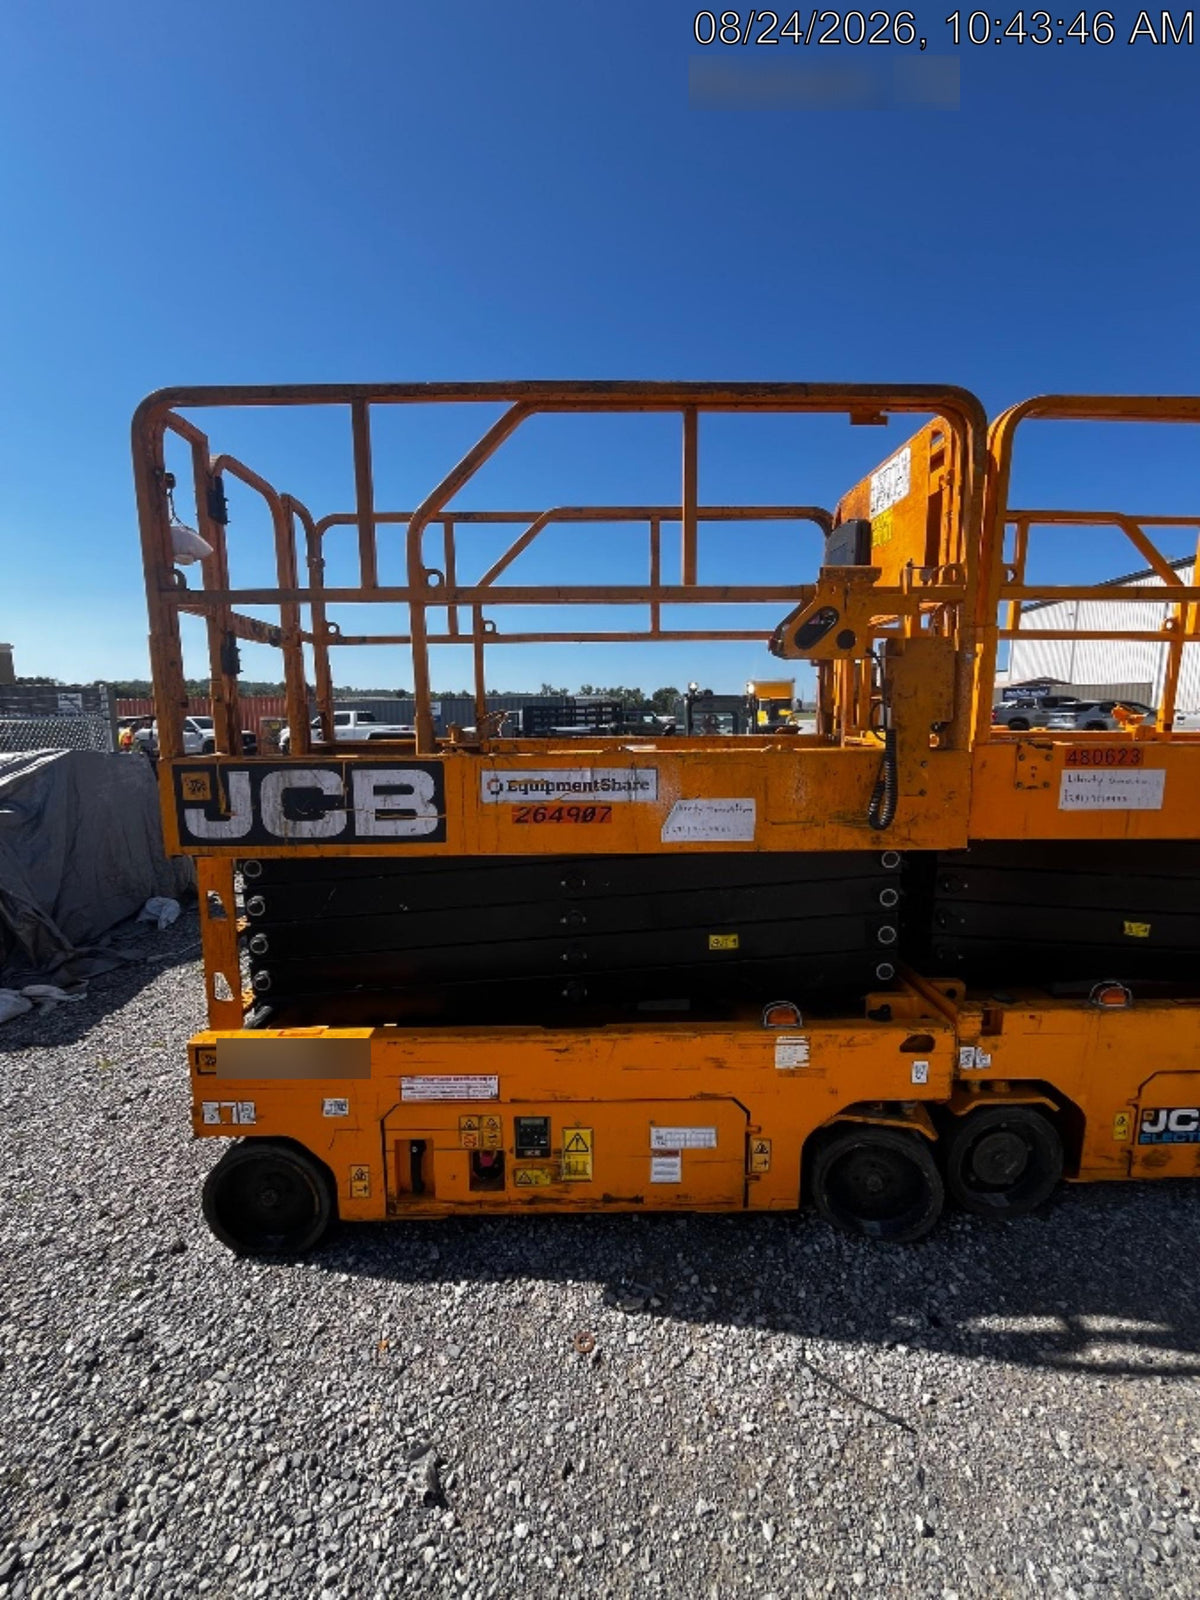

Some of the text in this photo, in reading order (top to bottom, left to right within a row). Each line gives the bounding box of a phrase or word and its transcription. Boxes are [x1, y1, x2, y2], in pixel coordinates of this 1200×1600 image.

[1067, 748, 1141, 766] 480623
[507, 777, 650, 797] EquipmentShare
[184, 769, 439, 839] JCB
[514, 806, 613, 824] 264907
[1141, 1109, 1200, 1133] JC
[1140, 1132, 1200, 1144] ELECT
